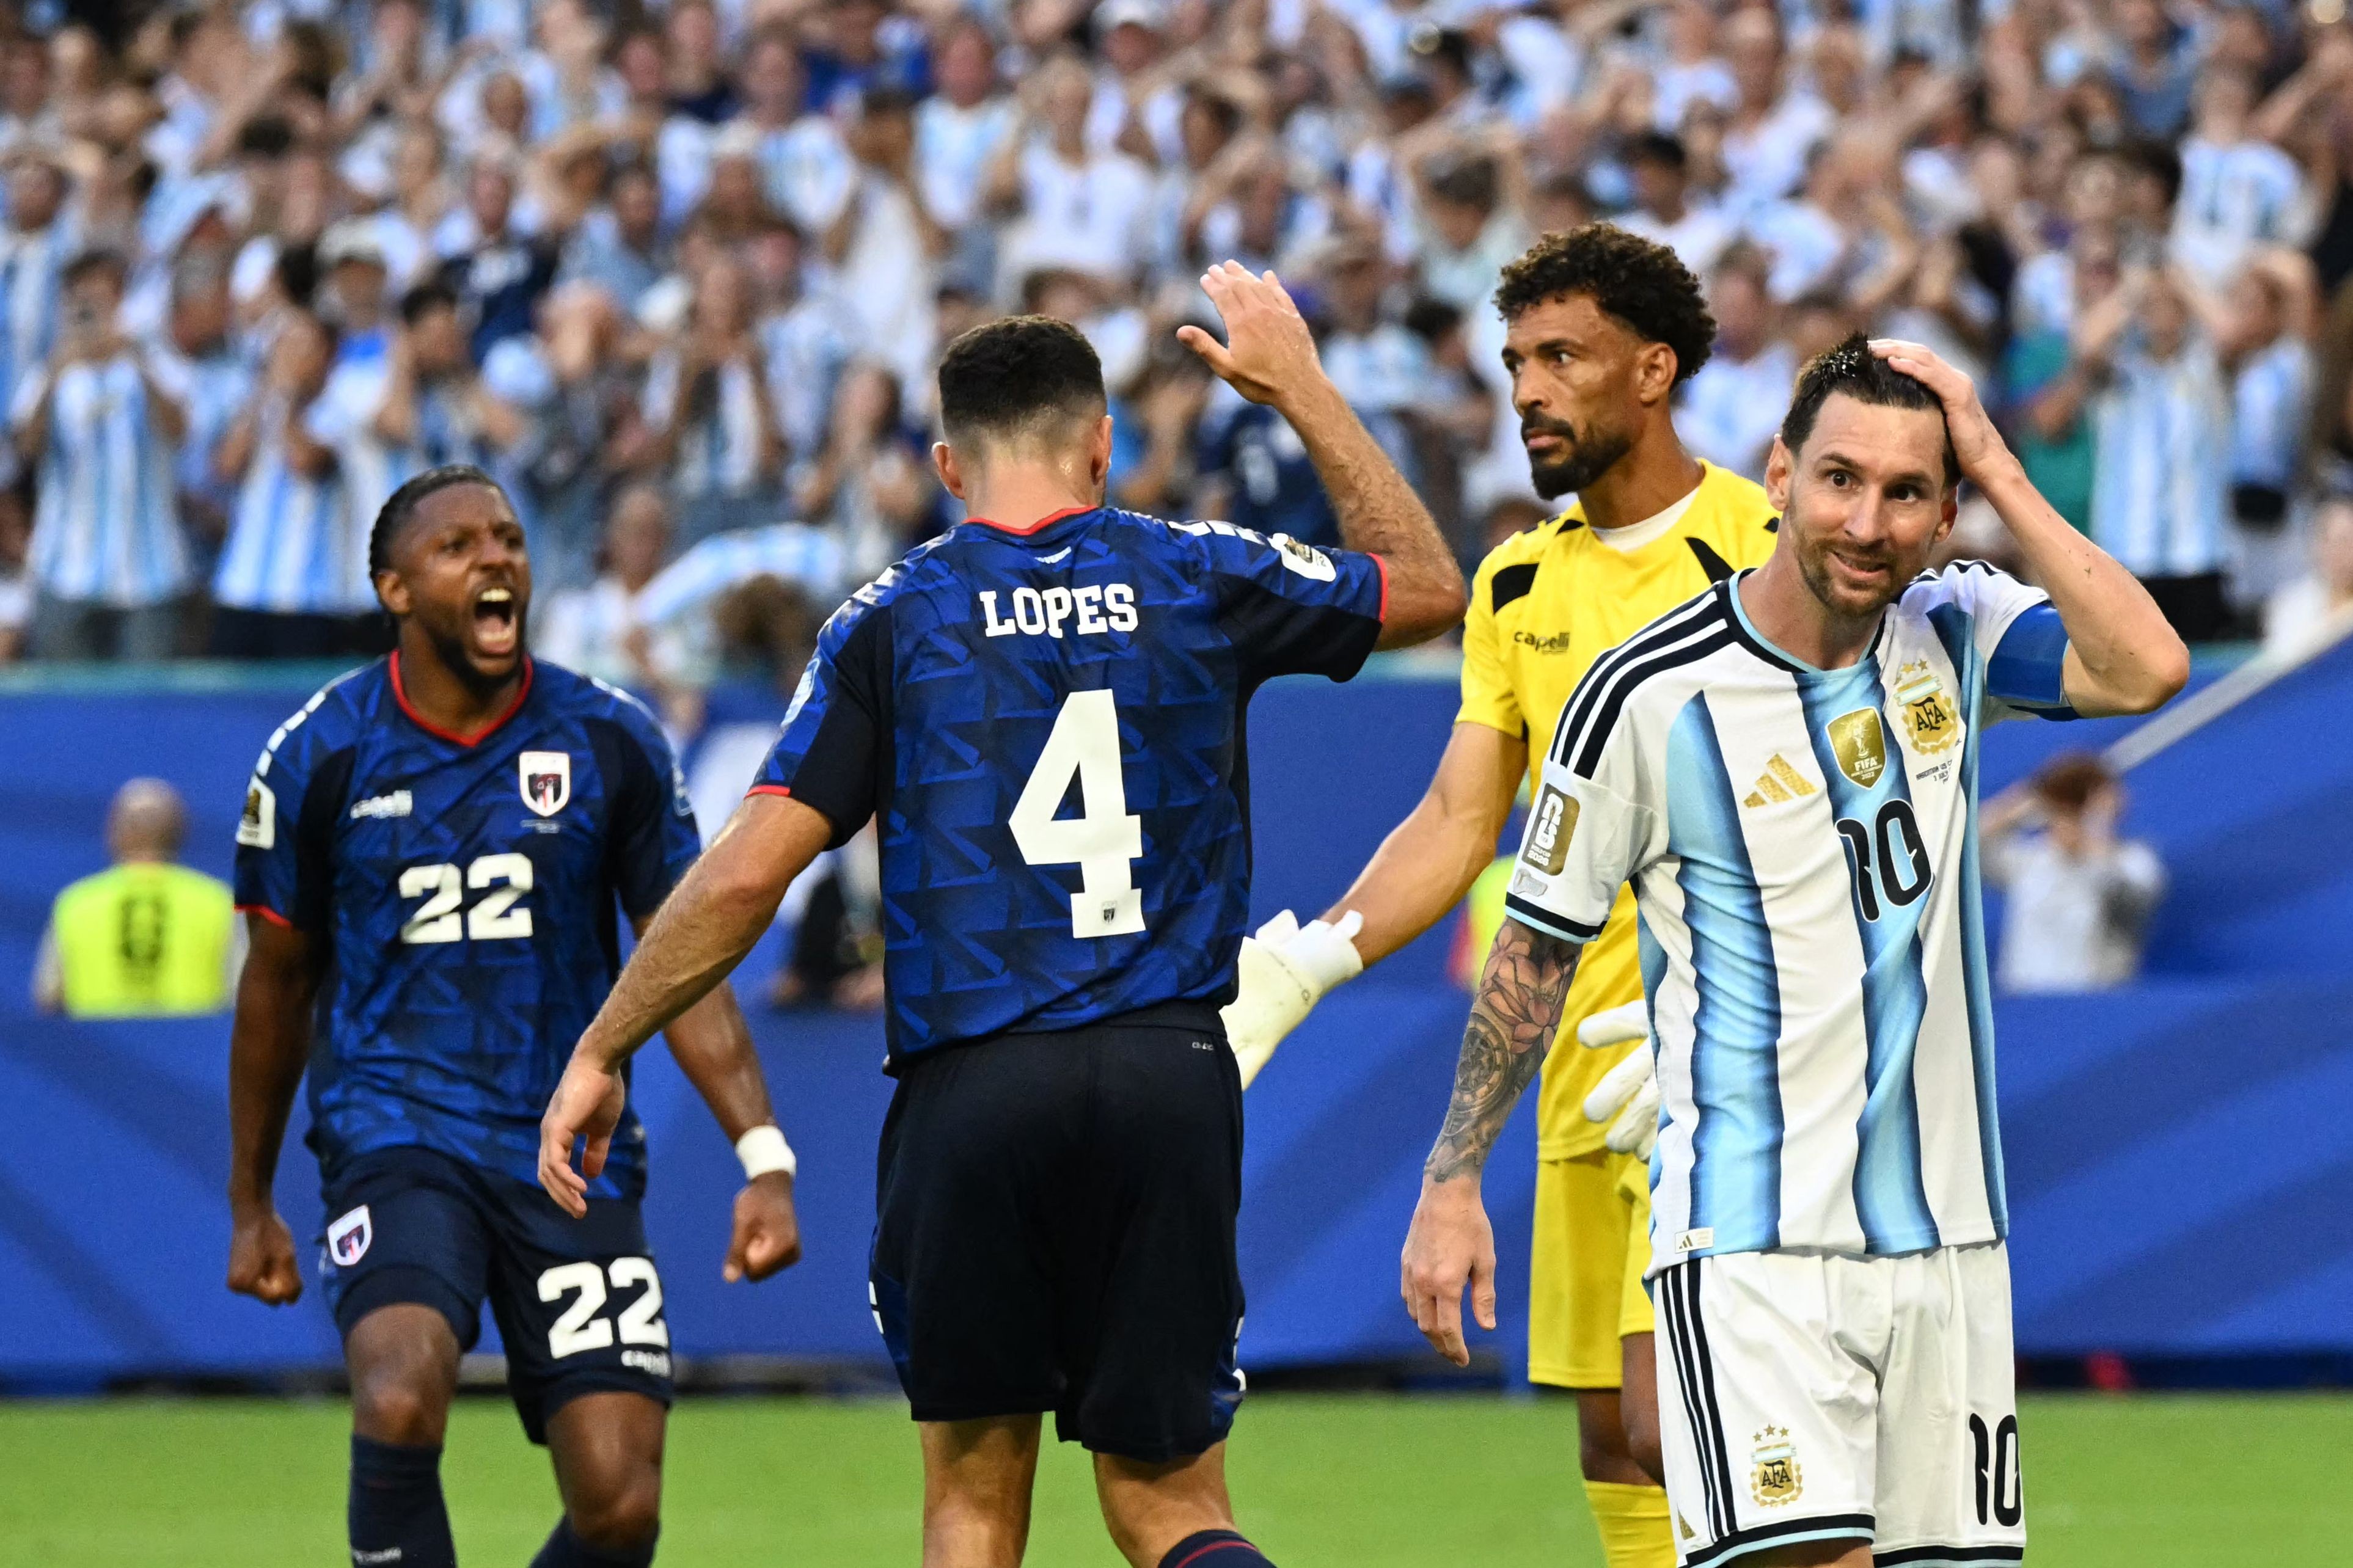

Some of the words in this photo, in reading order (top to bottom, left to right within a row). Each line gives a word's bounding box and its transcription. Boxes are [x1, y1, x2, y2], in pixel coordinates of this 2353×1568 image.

[979, 583, 1138, 638] LOPES
[1912, 696, 1947, 732] AFA
[1854, 757, 1878, 771] FIFA
[1008, 688, 1146, 939] 4
[398, 852, 534, 944] 22
[1834, 798, 1933, 923] 10
[536, 1256, 669, 1360] 22
[1761, 1459, 1791, 1489] AFA
[1969, 1413, 2021, 1527] 10
